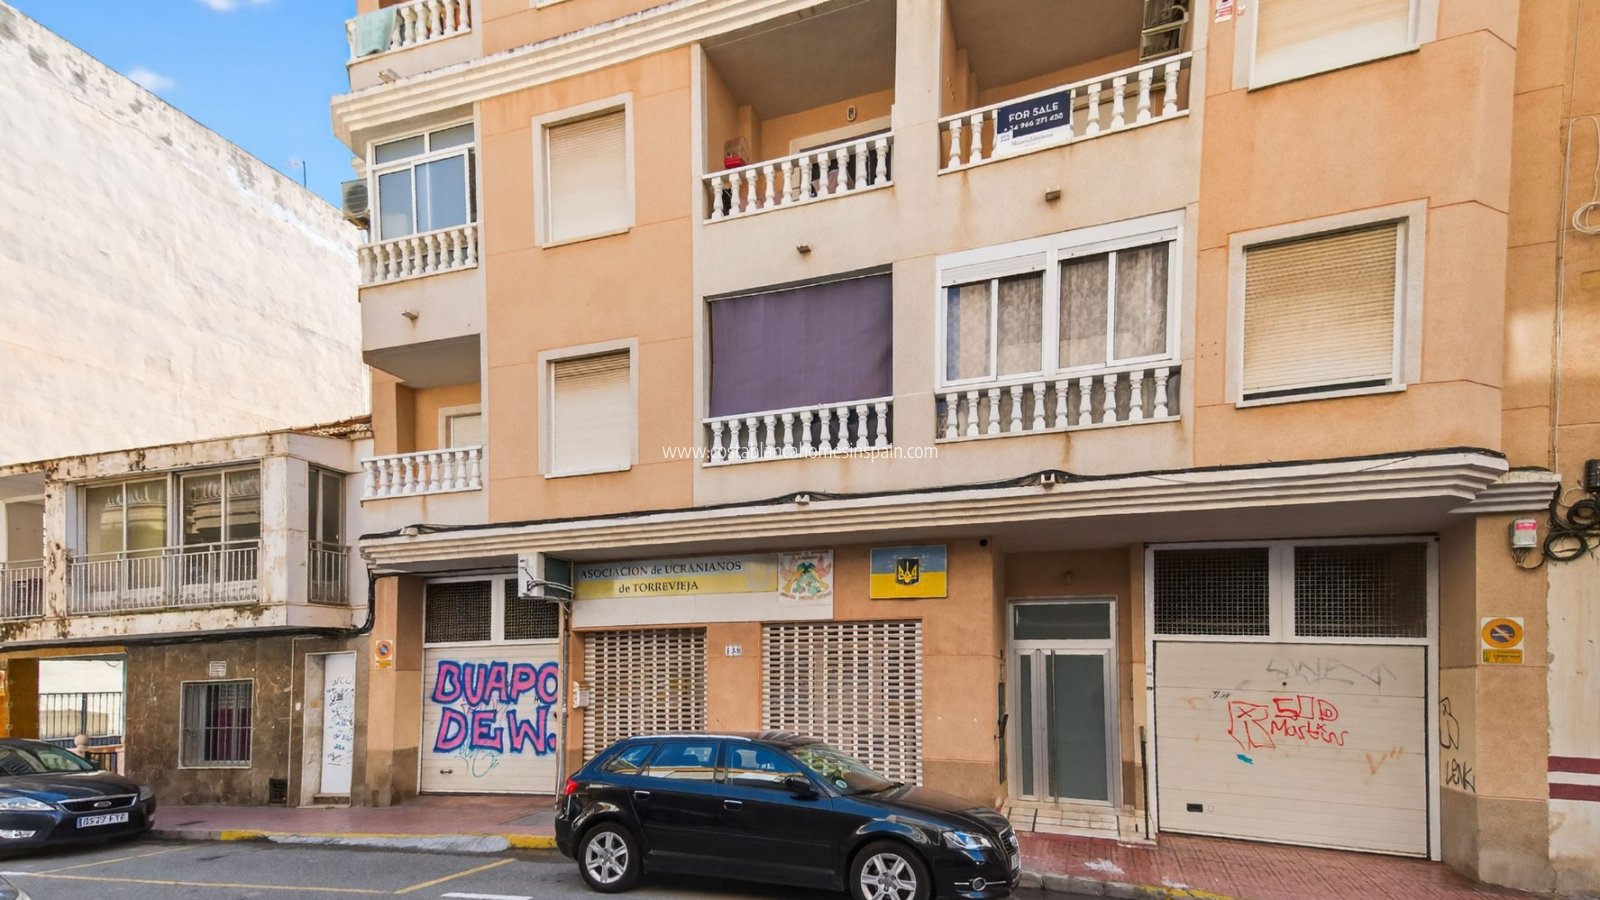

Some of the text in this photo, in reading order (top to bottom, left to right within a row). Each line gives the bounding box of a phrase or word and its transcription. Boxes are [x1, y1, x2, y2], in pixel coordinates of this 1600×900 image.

[1008, 102, 1059, 123] FOR SALE
[580, 560, 742, 579] ASOCIACION de UCRANIANOS
[618, 580, 699, 594] de TORREVIEJA
